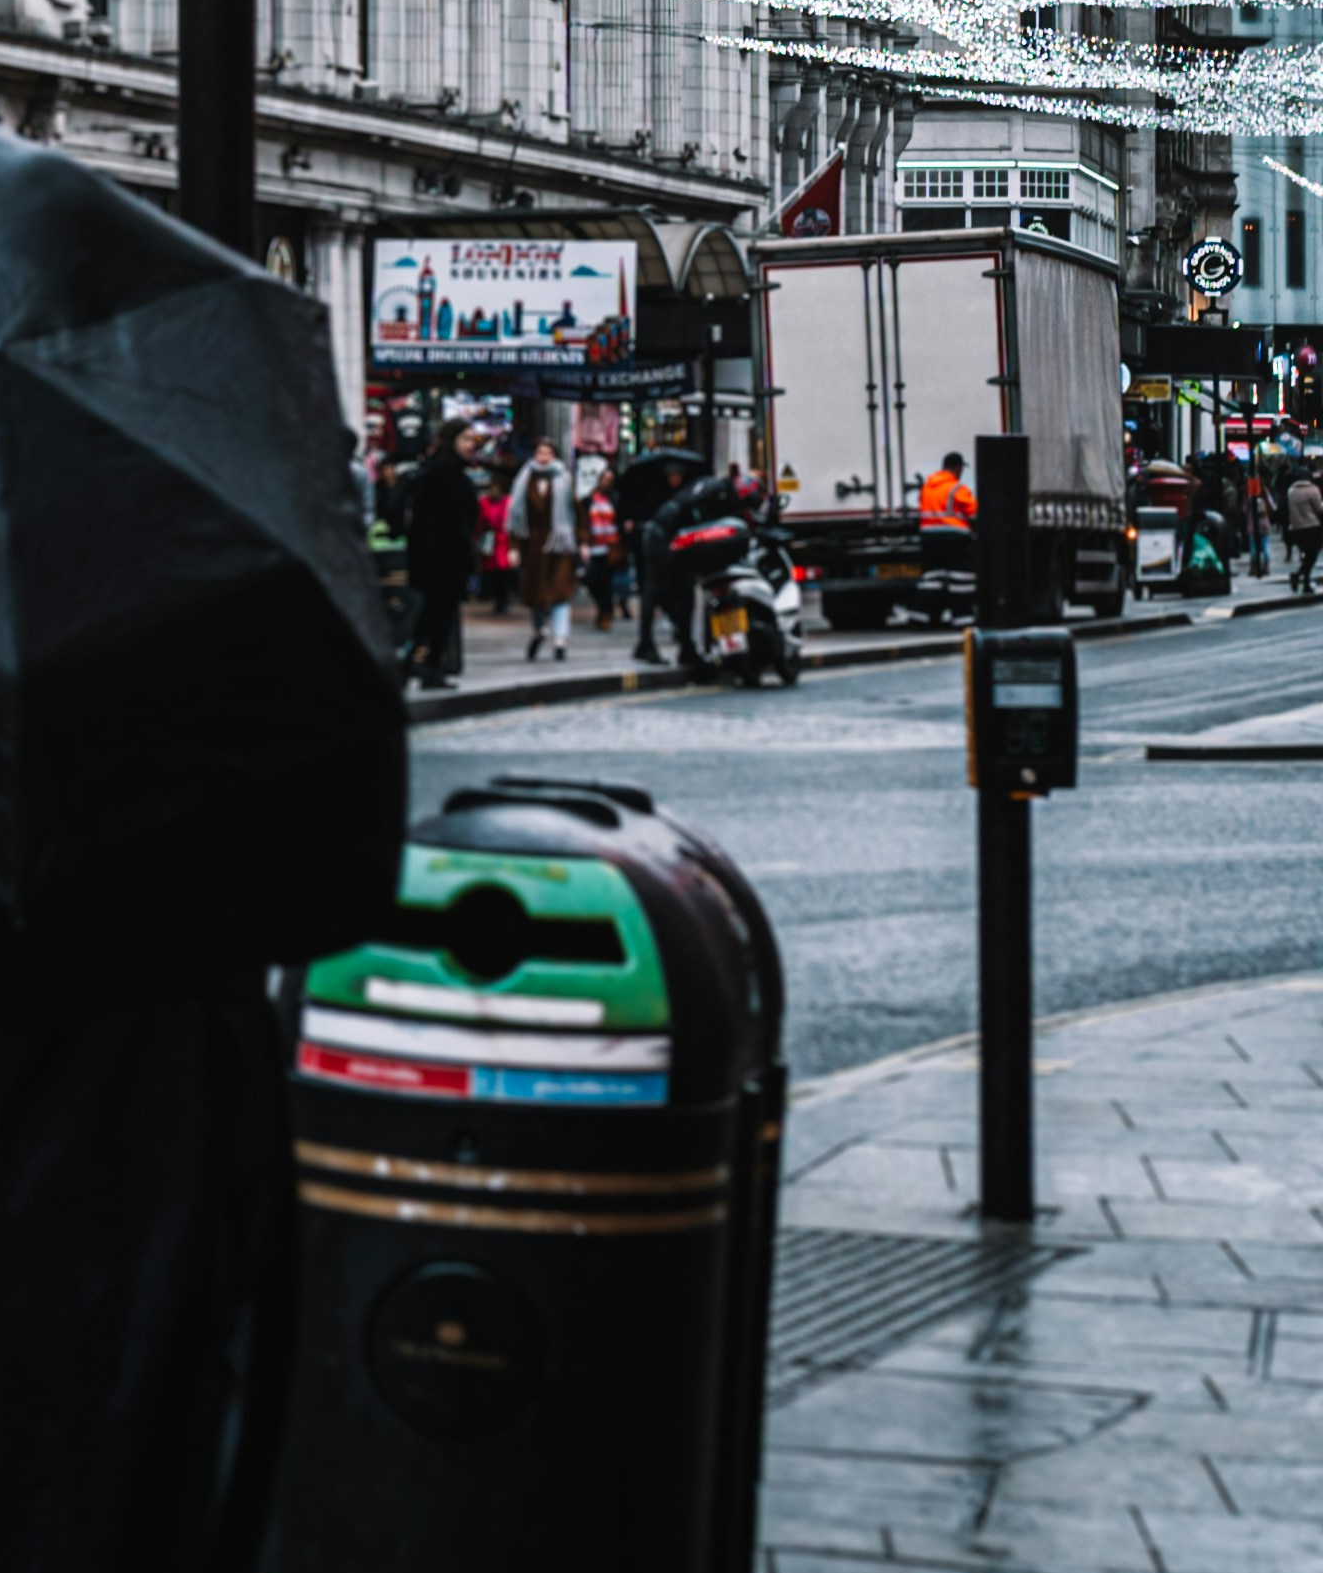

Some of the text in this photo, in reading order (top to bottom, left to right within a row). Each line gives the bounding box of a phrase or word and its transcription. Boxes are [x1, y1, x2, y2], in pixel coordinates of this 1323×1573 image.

[1191, 244, 1236, 266] GROSVENOR
[1200, 253, 1225, 279] G
[597, 363, 687, 386] EXCHANGE
